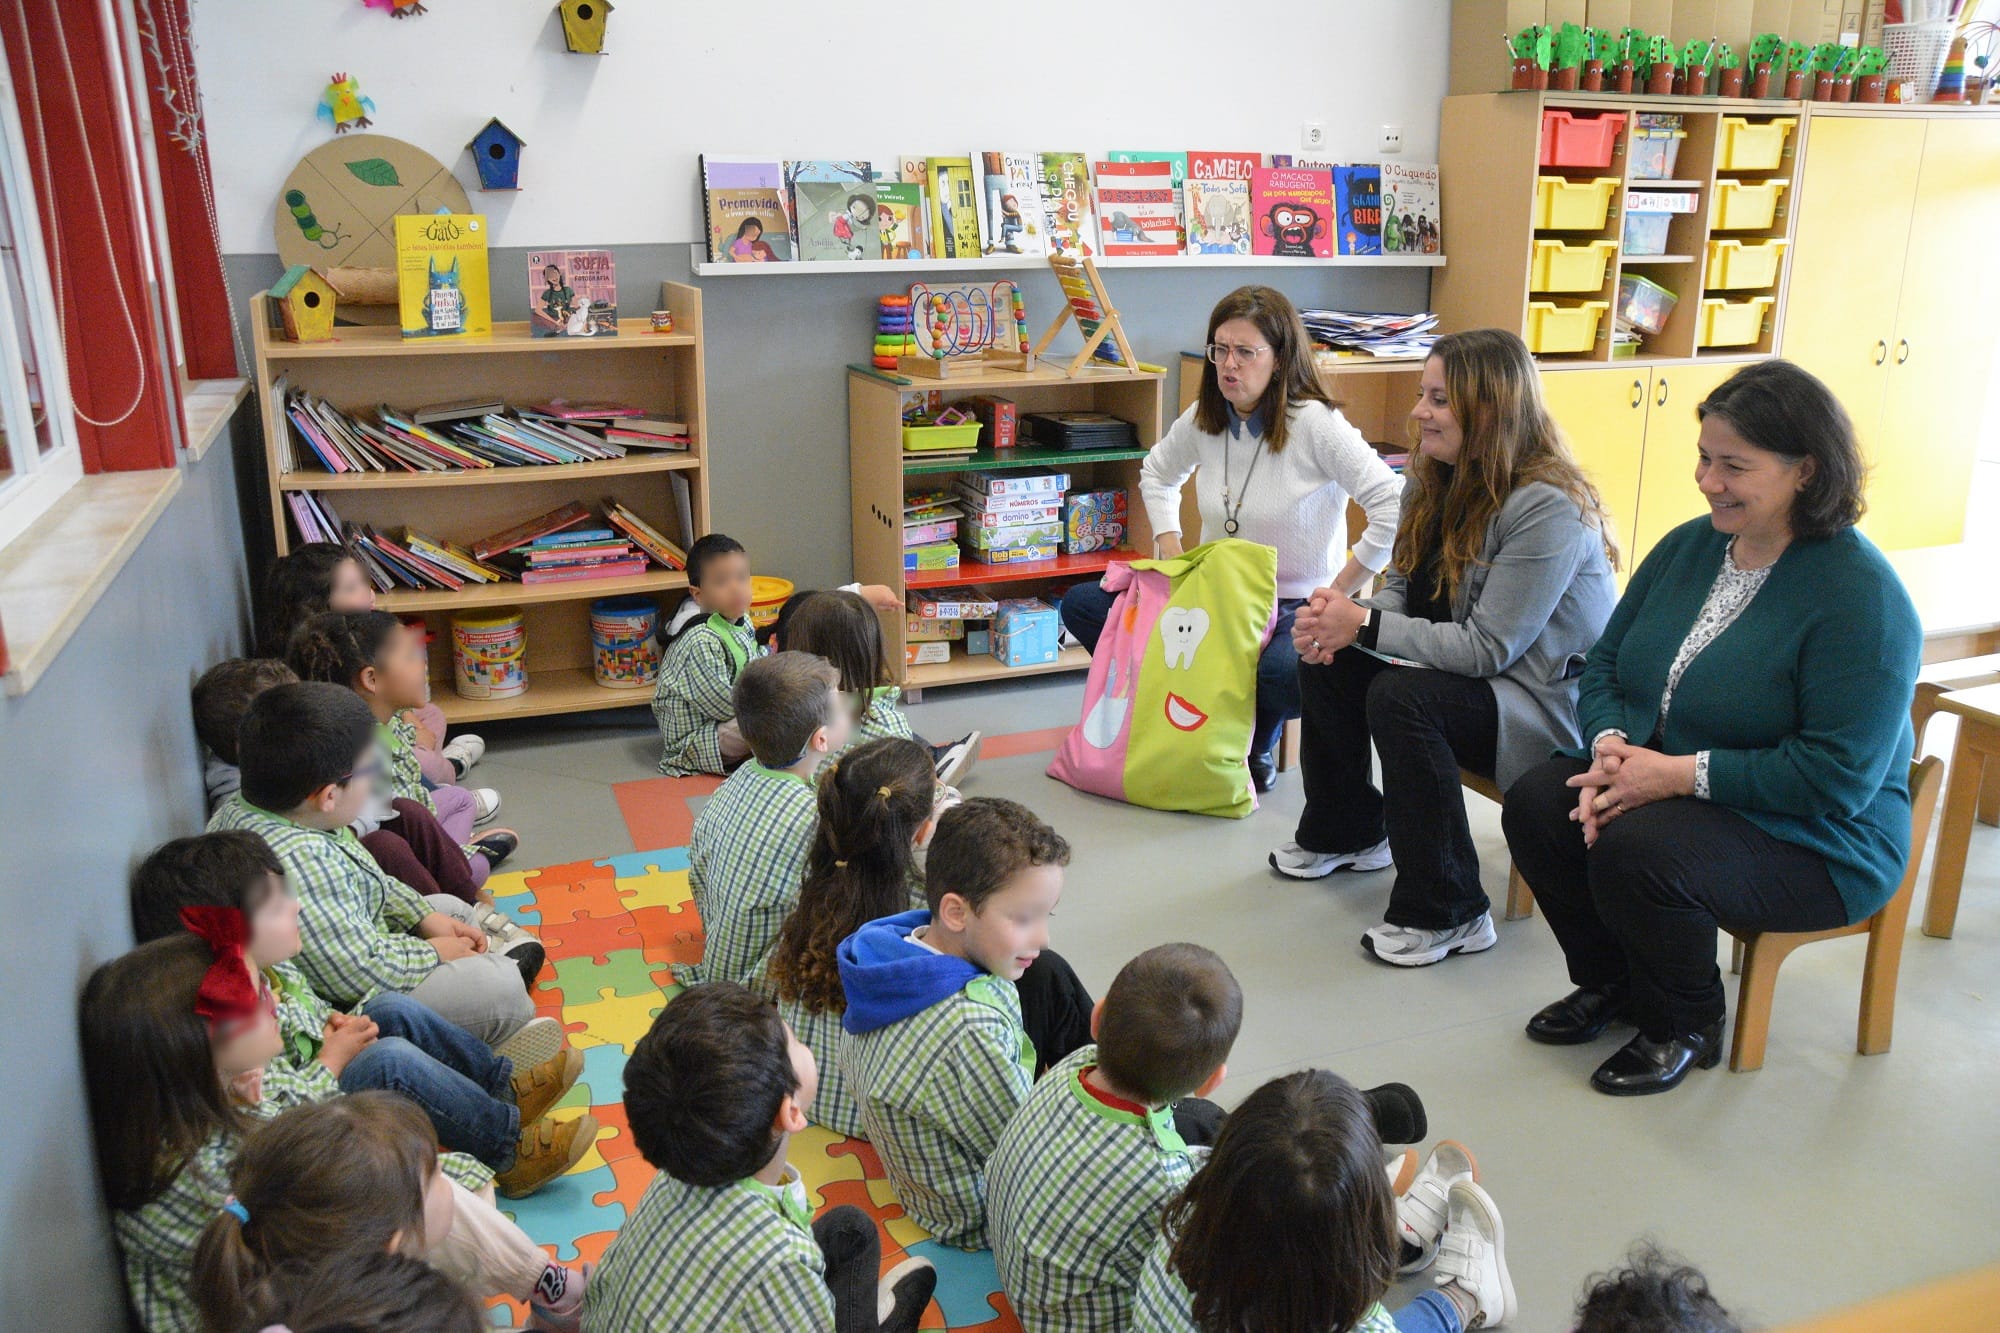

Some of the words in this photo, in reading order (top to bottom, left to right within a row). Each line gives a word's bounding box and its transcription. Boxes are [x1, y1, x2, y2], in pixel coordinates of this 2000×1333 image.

[1272, 172, 1278, 180] O
[1280, 172, 1314, 182] MACACO
[1385, 164, 1392, 175] O
[1394, 165, 1437, 181] Cuquedo
[1200, 182, 1221, 193] Todos
[1269, 180, 1316, 190] RABUGENTO
[1368, 183, 1374, 193] A
[1063, 161, 1080, 221] CHEGOU
[573, 256, 610, 271] SOFIA
[1009, 499, 1039, 508] NÚMEROS
[1002, 512, 1030, 522] domino
